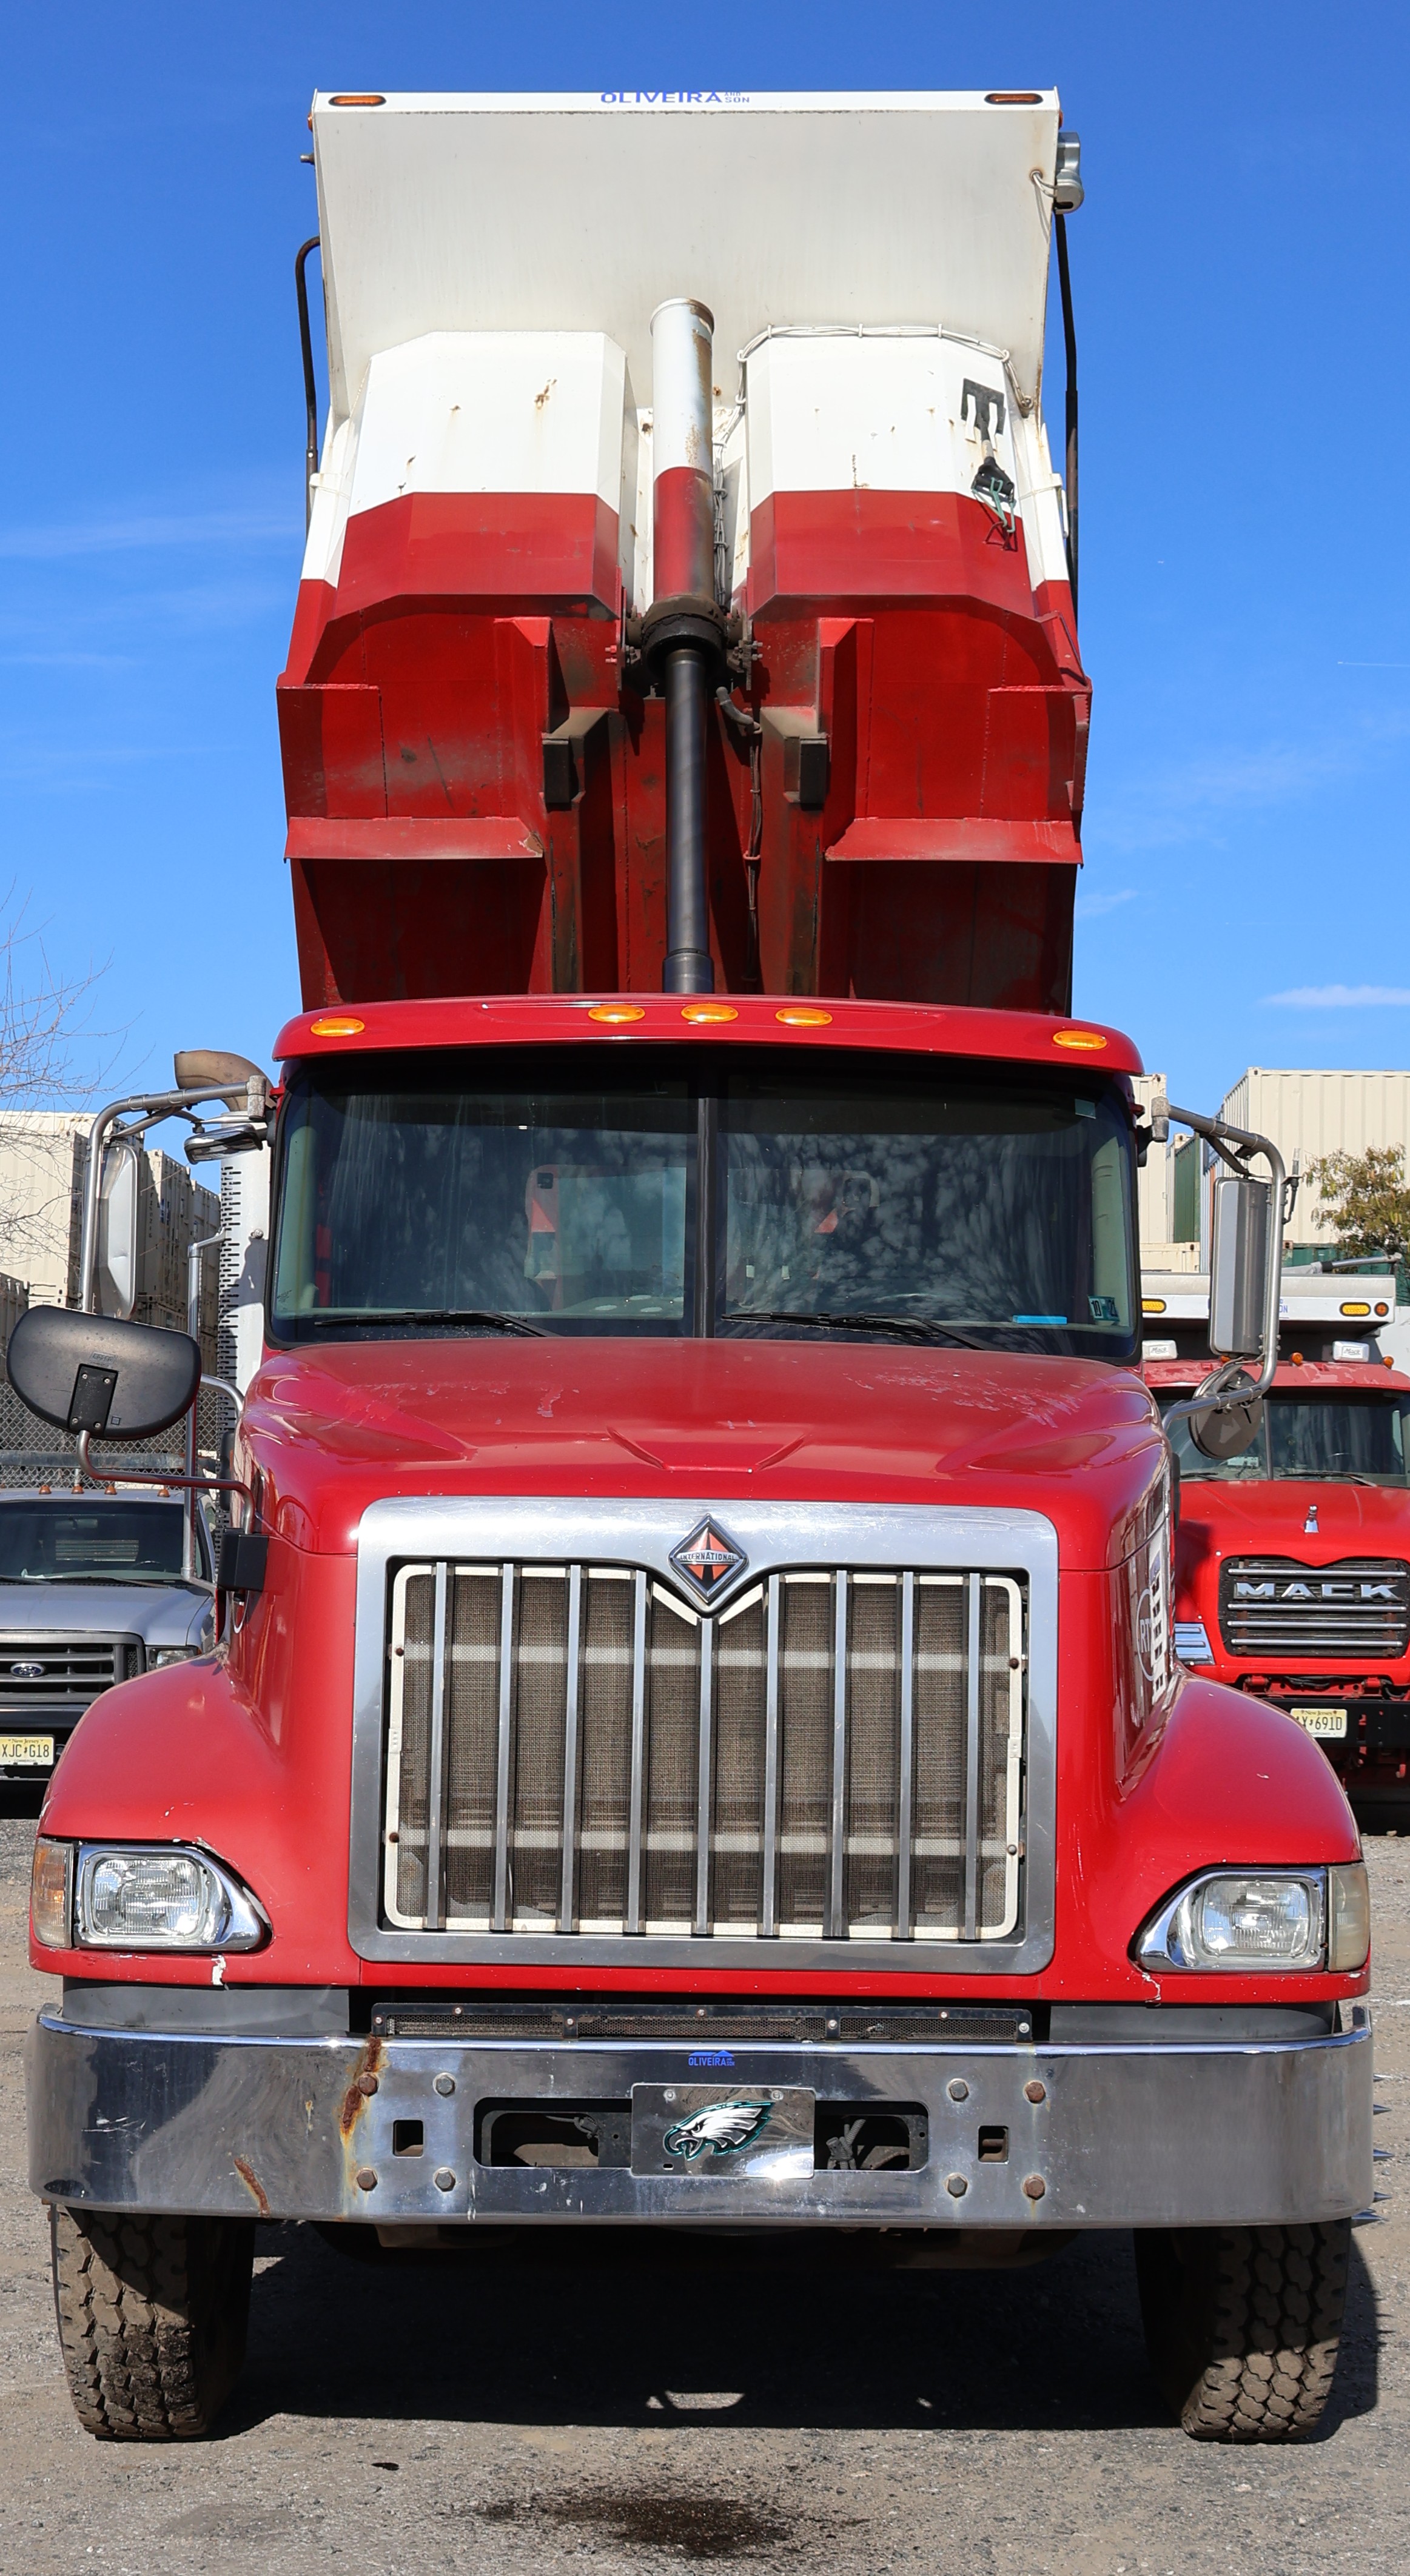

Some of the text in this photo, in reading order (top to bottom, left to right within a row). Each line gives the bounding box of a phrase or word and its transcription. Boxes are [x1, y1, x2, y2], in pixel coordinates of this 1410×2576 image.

[601, 90, 722, 103] OLIVEIRA
[1091, 1300, 1102, 1316] 10
[1279, 1305, 1289, 1313] ON
[680, 1552, 736, 1561] INTERNATIONAL
[1235, 1582, 1401, 1601] MACK
[688, 2057, 727, 2066] OLIVEIRA
